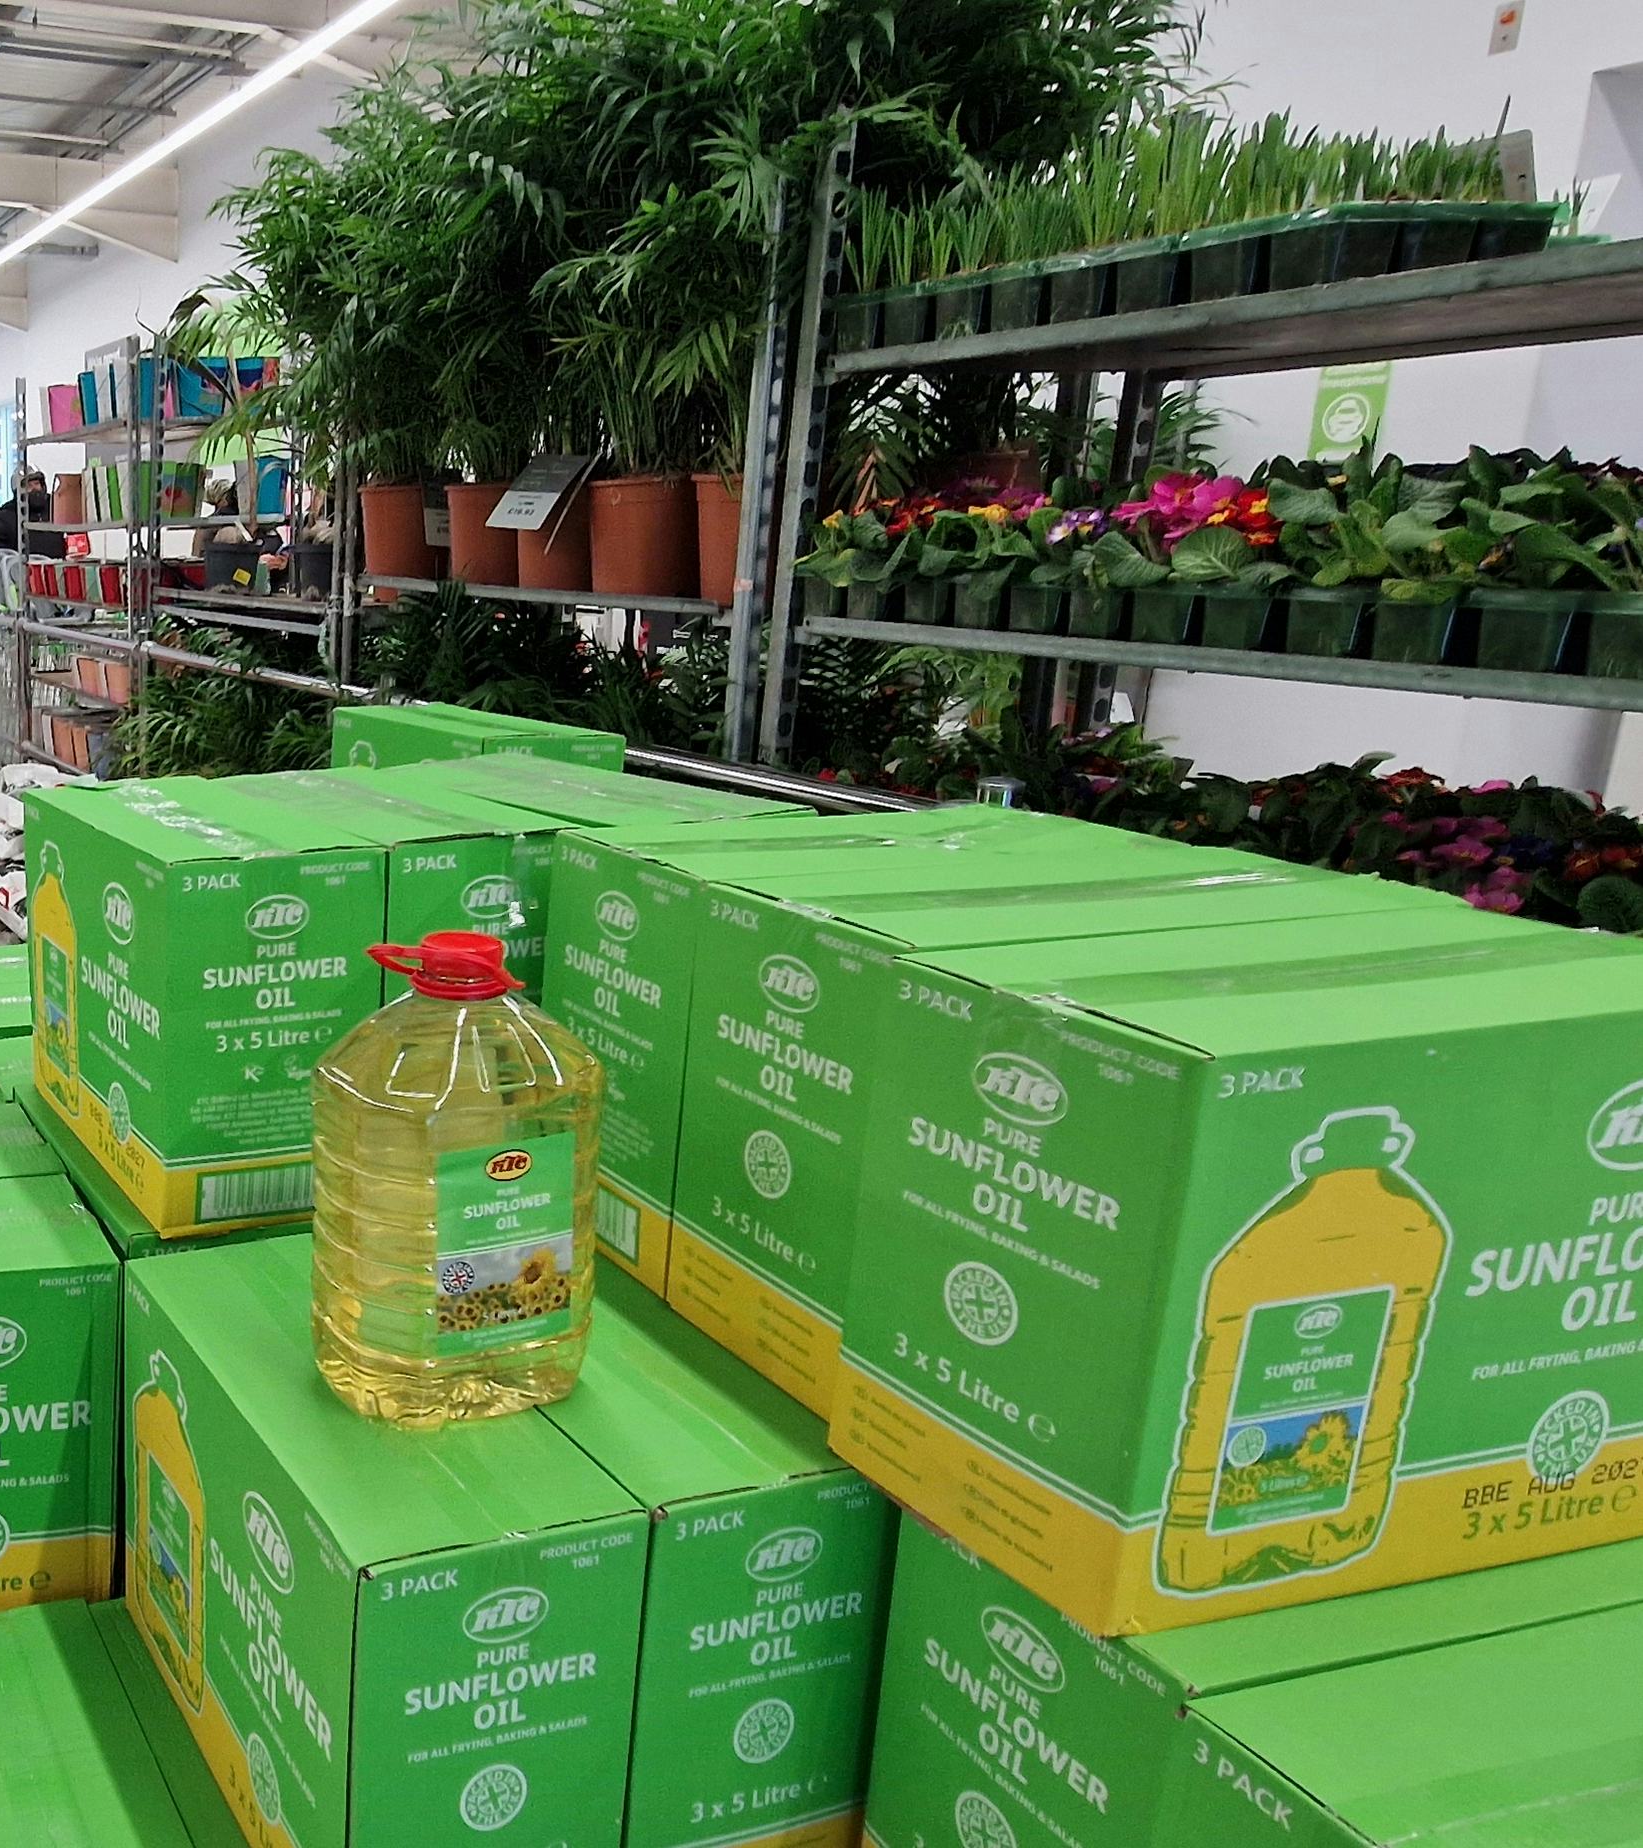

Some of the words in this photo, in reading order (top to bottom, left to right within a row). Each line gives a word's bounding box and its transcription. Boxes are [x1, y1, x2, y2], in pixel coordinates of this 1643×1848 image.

[182, 876, 192, 892] 3
[197, 873, 242, 891] PACK
[402, 857, 413, 874] 3
[415, 854, 457, 872] PACK
[251, 902, 304, 929] KTC
[108, 951, 130, 982] PURE
[256, 941, 297, 959] PURE
[598, 938, 628, 964] PURE
[202, 956, 348, 990] SUNFLOWER
[564, 943, 662, 1010] SUNFLOWER
[80, 954, 161, 1043] SUNFLOWER
[255, 986, 296, 1010] OIL
[593, 985, 621, 1018] OIL
[898, 978, 912, 1001] 3
[918, 985, 973, 1022] PACK
[107, 1008, 130, 1051] OIL
[215, 1034, 228, 1054] 3
[233, 1037, 245, 1050] x
[250, 1031, 263, 1050] 5
[267, 1028, 310, 1048] Litre
[765, 1008, 805, 1041] PURE
[716, 1013, 854, 1096] SUNFLOWER
[760, 1064, 798, 1103] OIL
[1217, 1075, 1235, 1099] 3
[1240, 1064, 1307, 1095] PACK
[983, 1116, 1042, 1158] PURE
[908, 1115, 1121, 1232] SUNFLOWER
[463, 1192, 551, 1220] SUNFLOWER
[495, 1215, 521, 1231] OIL
[972, 1182, 1029, 1233] OIL
[1588, 1191, 1643, 1227] PUR
[1464, 1226, 1643, 1297] SUNFLO
[1560, 1279, 1637, 1332] OIL
[894, 1331, 908, 1358] 3
[913, 1349, 930, 1373] x
[935, 1356, 952, 1384] 5
[958, 1367, 1020, 1425] Litre
[1263, 1353, 1355, 1381] SUNFLOWER
[1472, 1364, 1499, 1381] FOR
[1501, 1361, 1527, 1377] ALL
[1528, 1350, 1582, 1371] FRYING,
[1584, 1340, 1636, 1362] BAKING
[1291, 1376, 1318, 1394] OIL
[19, 1476, 28, 1487] &
[28, 1472, 70, 1486] SALADS
[1461, 1480, 1513, 1510] BBE
[1591, 1455, 1643, 1486] 202
[675, 1520, 688, 1541] 3
[692, 1509, 746, 1538] PACK
[1462, 1510, 1482, 1540] 3
[1488, 1512, 1507, 1536] x
[1514, 1501, 1534, 1530] 5
[1539, 1494, 1605, 1526] Litre
[539, 1537, 598, 1561] PRODUCT
[600, 1531, 634, 1549] CODE
[571, 1554, 601, 1570] 1061
[380, 1582, 394, 1602] 3
[401, 1567, 459, 1598] PACK
[755, 1581, 805, 1608] PURE
[249, 1572, 282, 1639] PURE
[470, 1594, 541, 1634] KTC
[689, 1591, 864, 1652] SUNFLOWER
[210, 1536, 332, 1764] SUNFLOWER
[476, 1641, 531, 1669] PURE
[749, 1635, 798, 1667] OIL
[985, 1616, 1058, 1683] KTC
[247, 1641, 283, 1724] OIL
[404, 1652, 598, 1716] SUNFLOWER
[1094, 1655, 1125, 1687] 1061
[1127, 1659, 1167, 1698] CODE
[989, 1663, 1043, 1721] PURE
[473, 1697, 527, 1731] OIL
[924, 1637, 1109, 1816] SUNFLOWER
[408, 1749, 430, 1764] FOR
[431, 1746, 451, 1759] ALL
[496, 1726, 538, 1744] BAKING
[548, 1714, 589, 1734] SALADS
[978, 1722, 1029, 1786] OIL
[1192, 1737, 1211, 1766] 3
[1216, 1752, 1294, 1833] PACK
